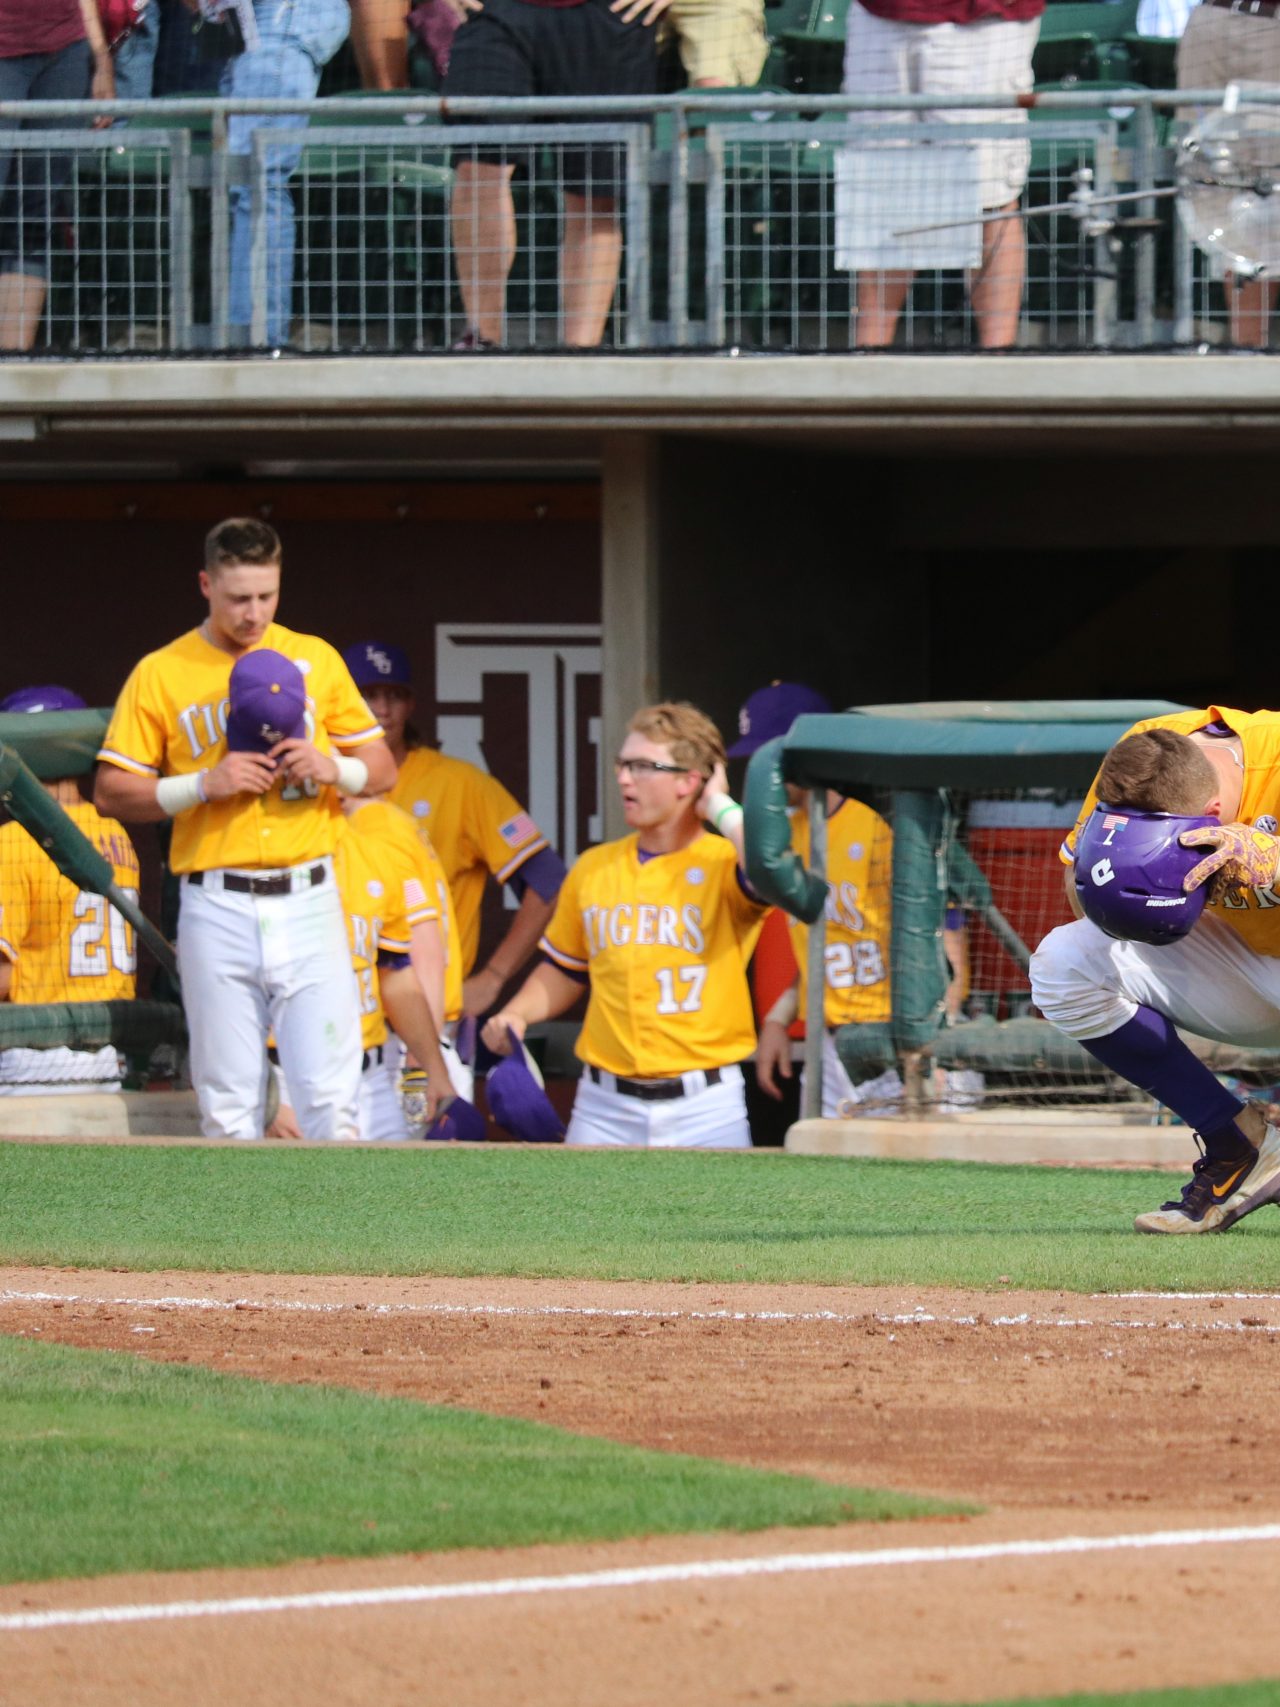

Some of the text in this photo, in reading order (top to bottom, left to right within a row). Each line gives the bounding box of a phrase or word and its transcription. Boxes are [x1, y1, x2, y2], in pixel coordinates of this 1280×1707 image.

[69, 887, 139, 977] 20
[582, 903, 705, 959] TIGERS
[655, 964, 707, 1015] 17
[824, 941, 885, 988] 28
